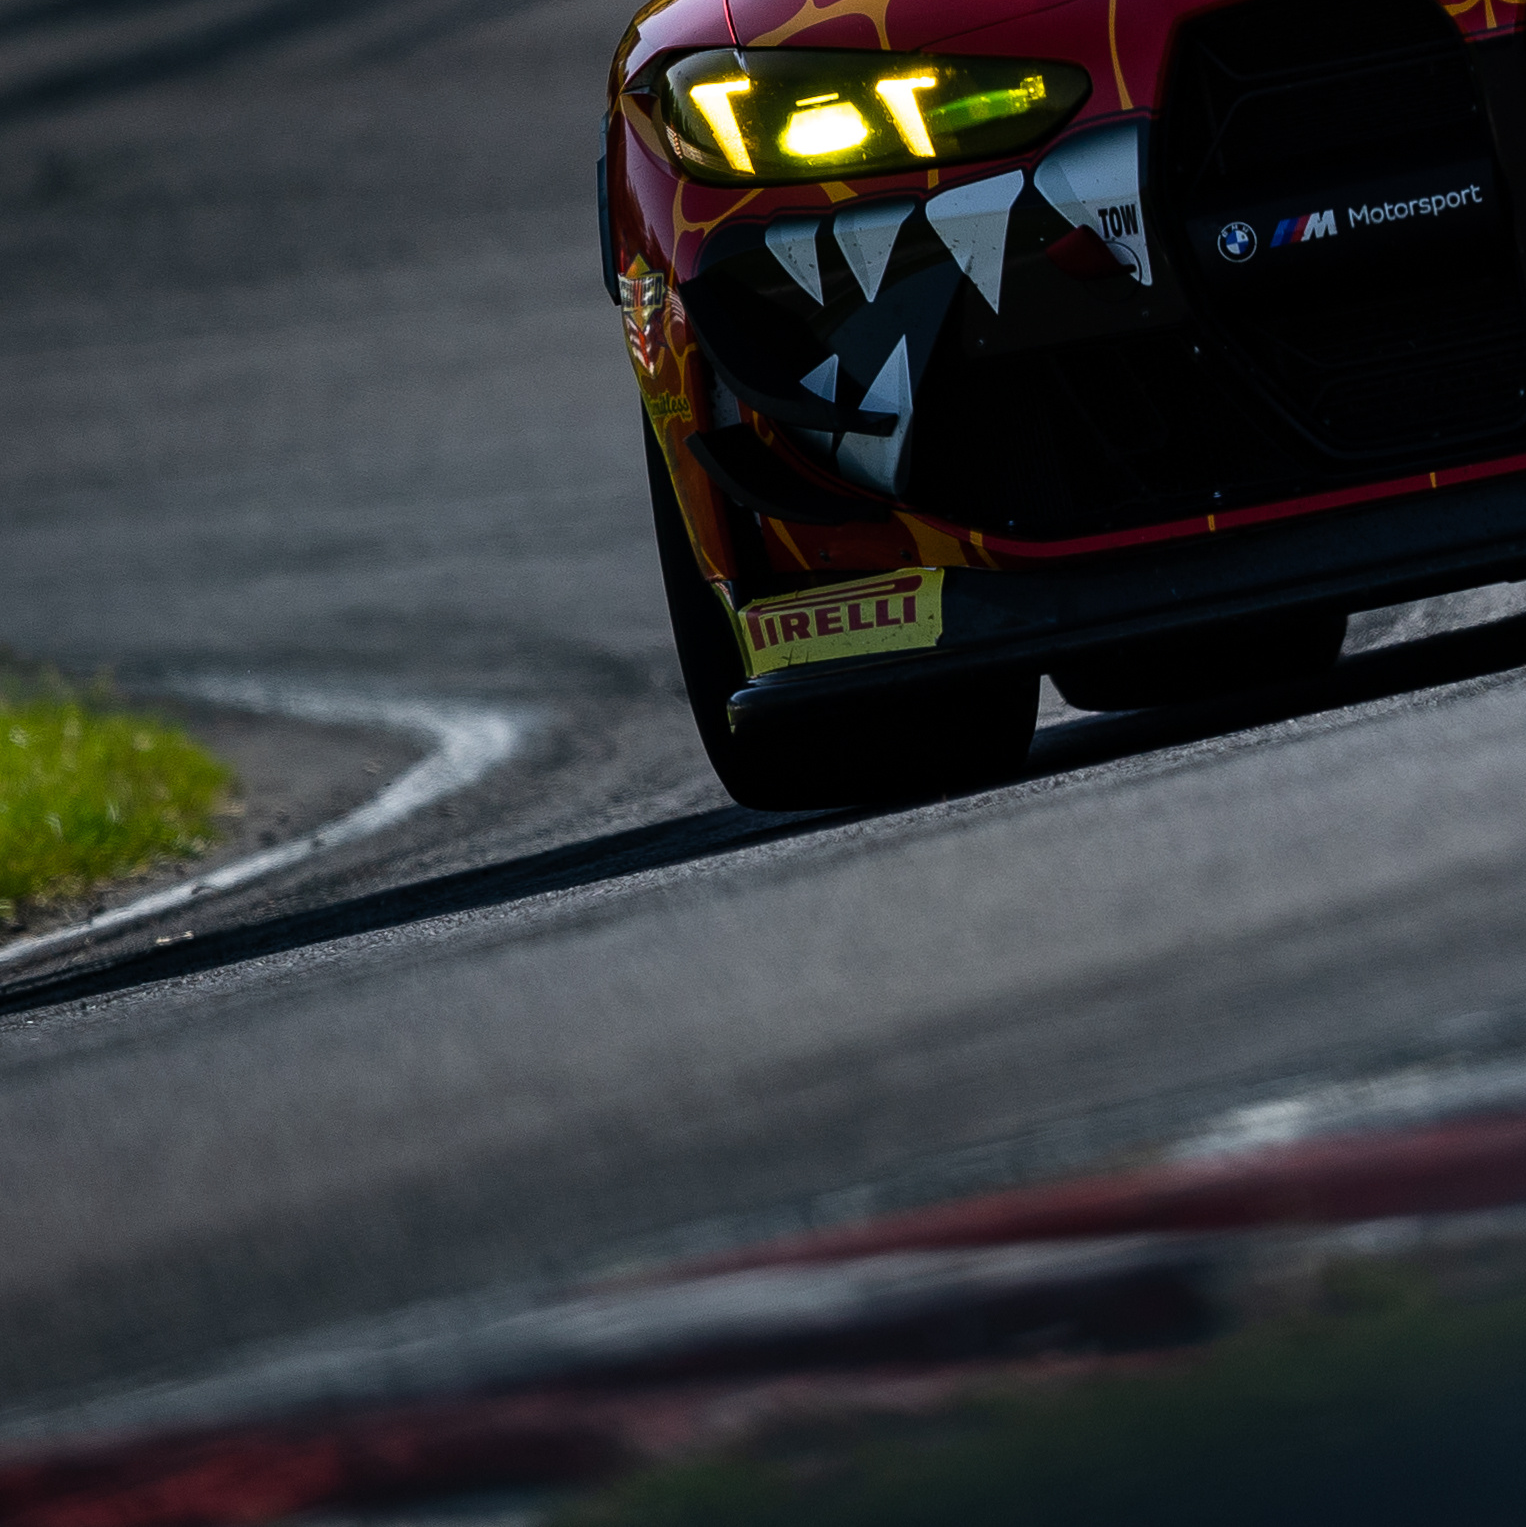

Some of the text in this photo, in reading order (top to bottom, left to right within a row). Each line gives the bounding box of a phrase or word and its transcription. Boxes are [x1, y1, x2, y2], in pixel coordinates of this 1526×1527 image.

[1097, 203, 1139, 239] TOW
[1348, 184, 1483, 228] Motorsport
[746, 575, 923, 652] PIRELLI
